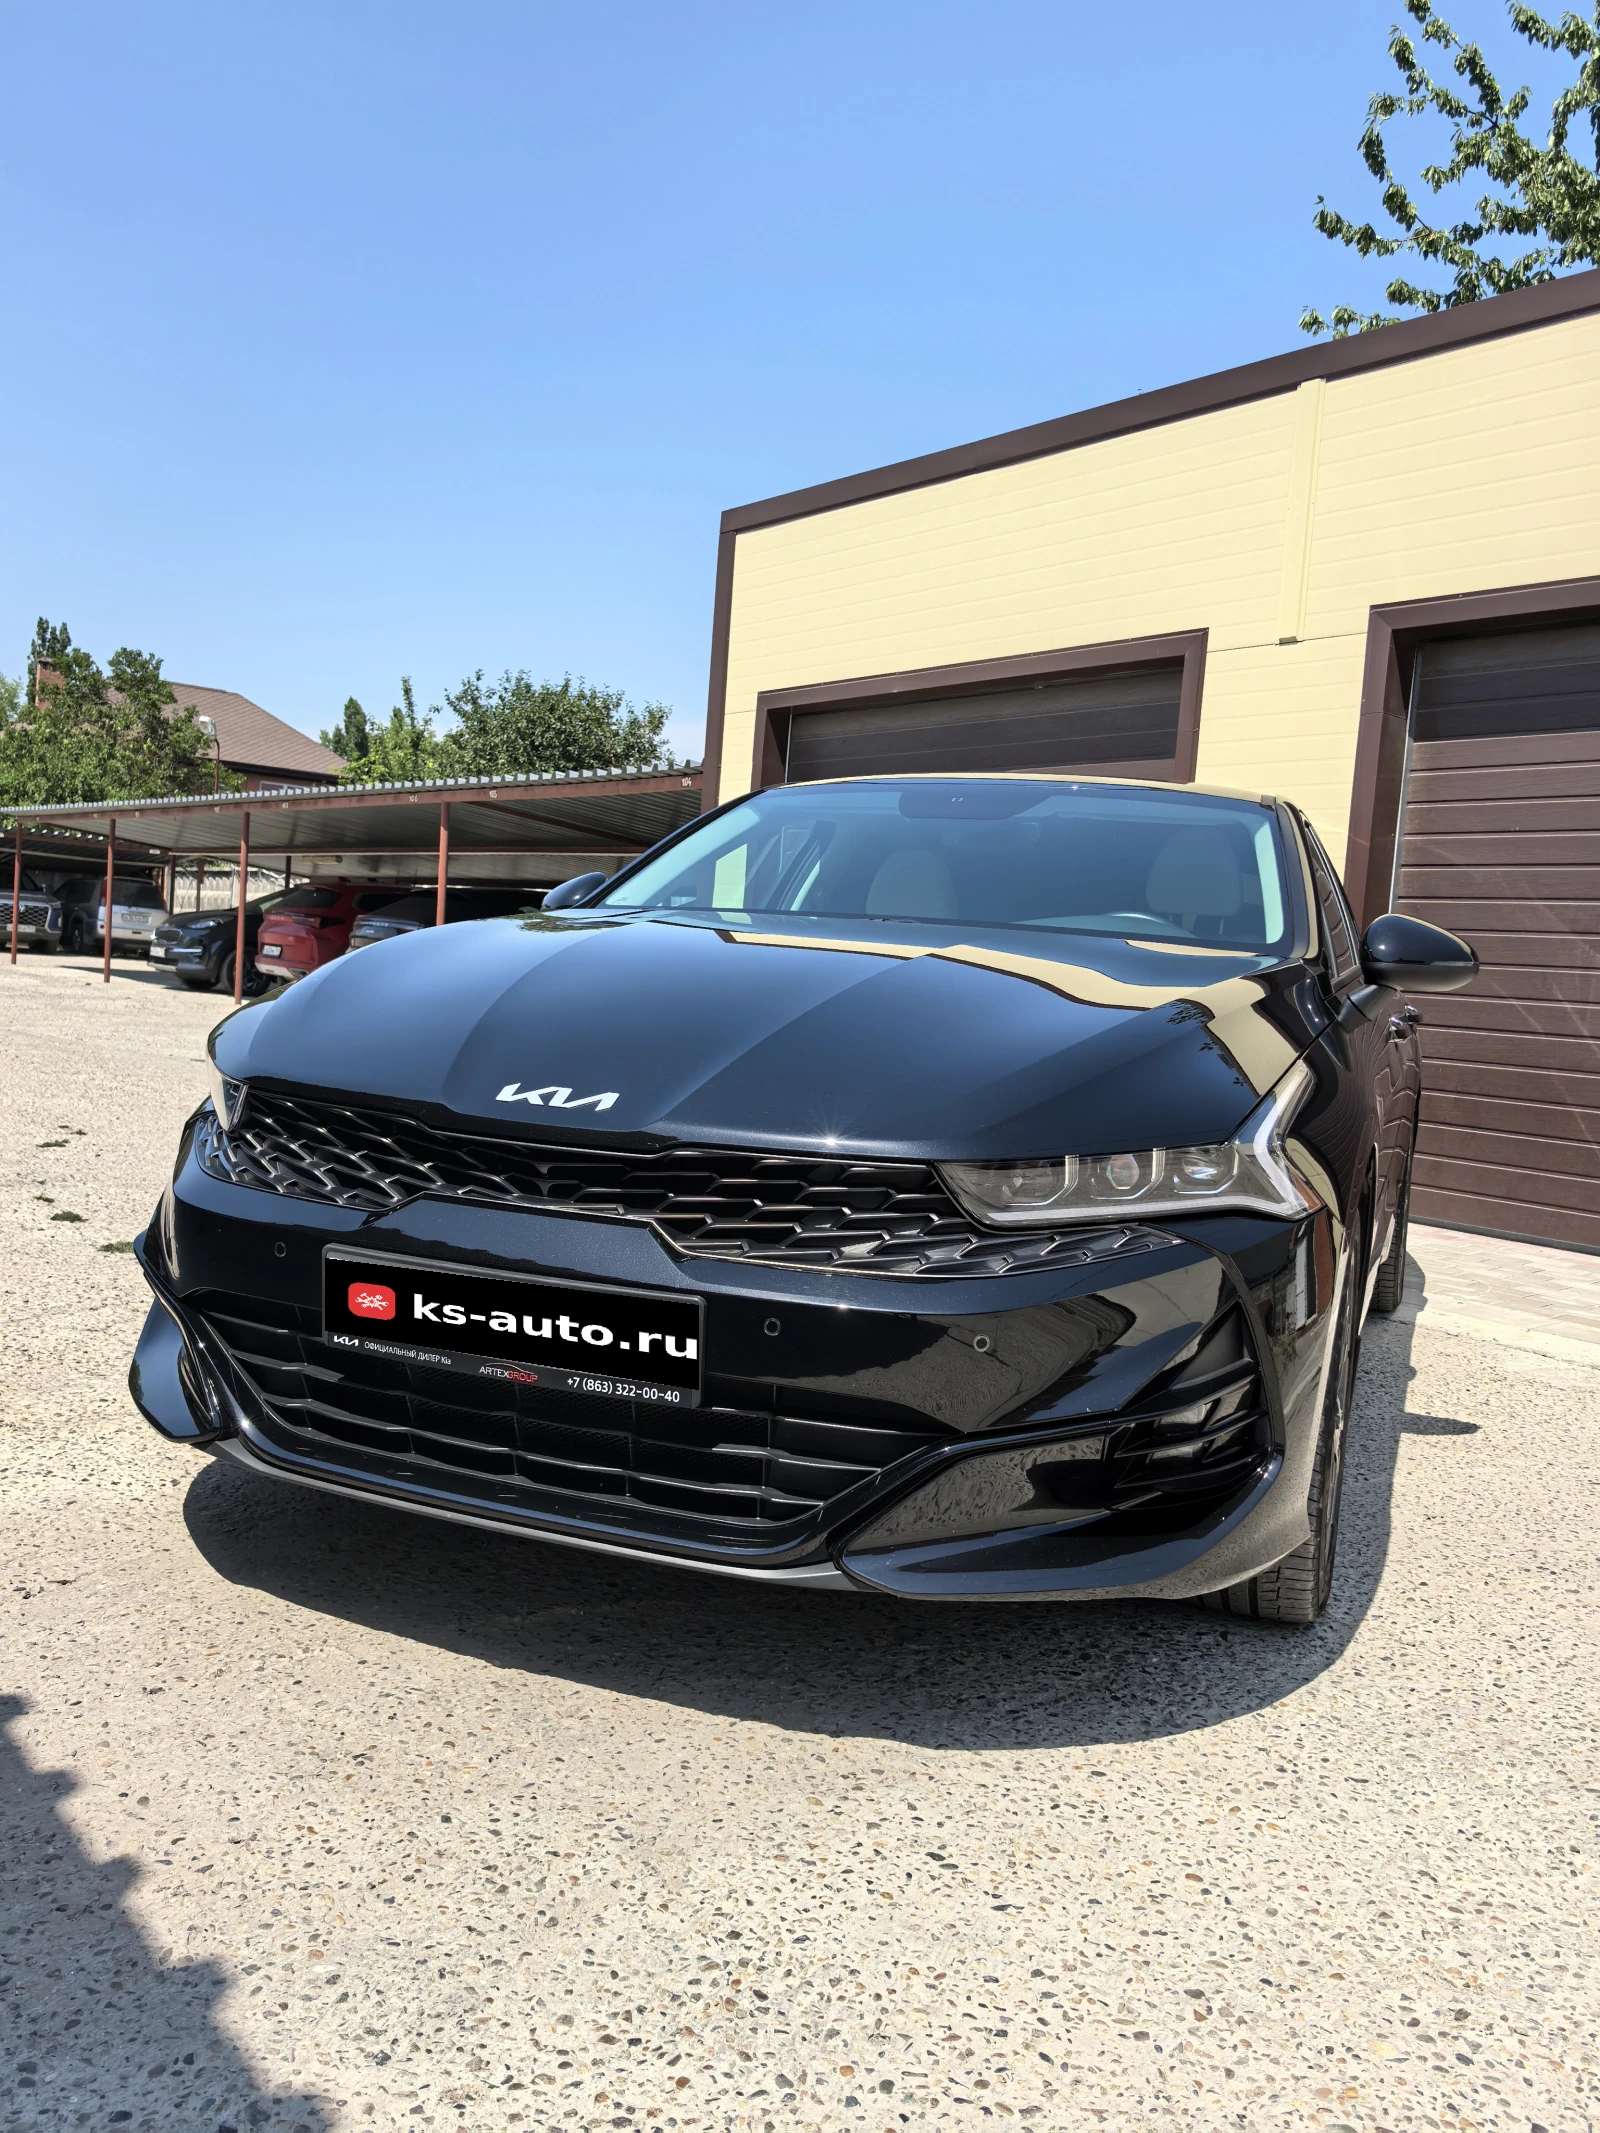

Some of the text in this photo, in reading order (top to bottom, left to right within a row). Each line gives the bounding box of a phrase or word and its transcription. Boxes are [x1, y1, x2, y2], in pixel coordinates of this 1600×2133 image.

[681, 776, 692, 787] 104
[496, 1083, 620, 1112] KIA
[333, 1334, 359, 1347] KIA
[364, 1341, 452, 1365] ОФИЦИАЛЬНЫЙ ДИЛЕР Kia
[567, 1377, 681, 1403] +7 (863) 322-00-40
